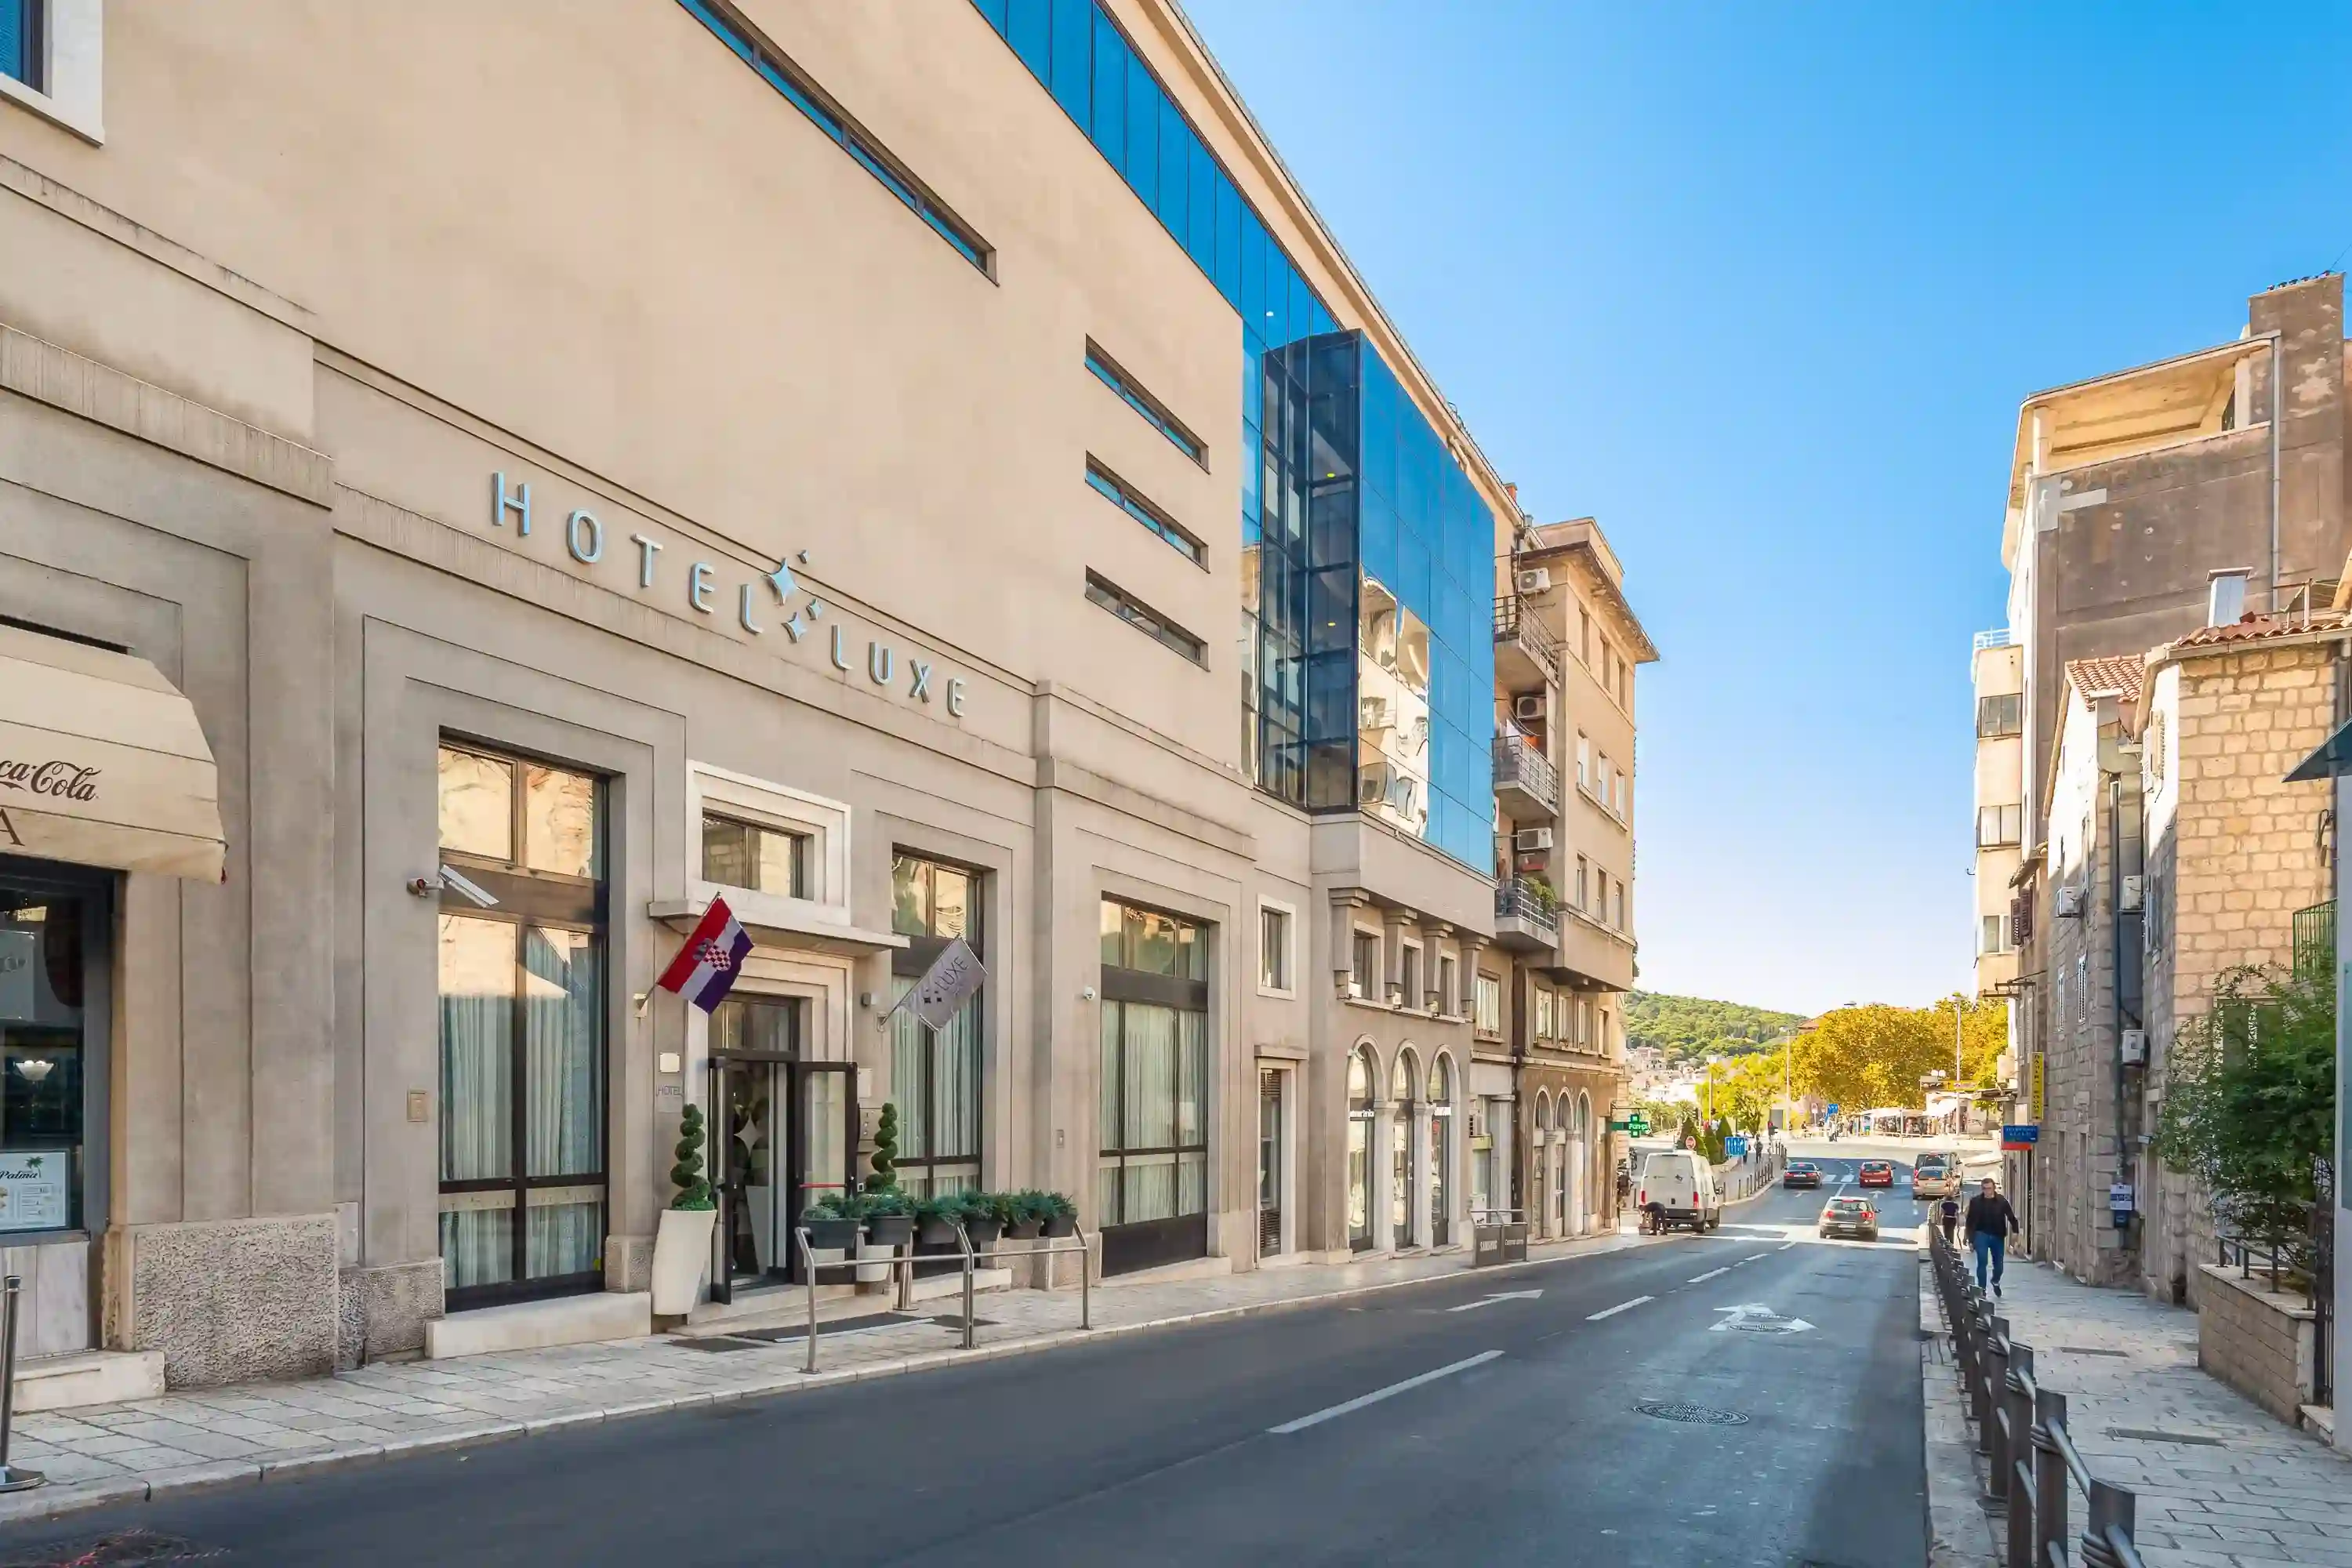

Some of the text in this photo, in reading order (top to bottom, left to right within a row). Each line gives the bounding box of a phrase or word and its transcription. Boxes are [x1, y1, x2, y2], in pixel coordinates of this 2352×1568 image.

[492, 471, 967, 718] HOTEL LUXE
[934, 956, 969, 992] LUXE
